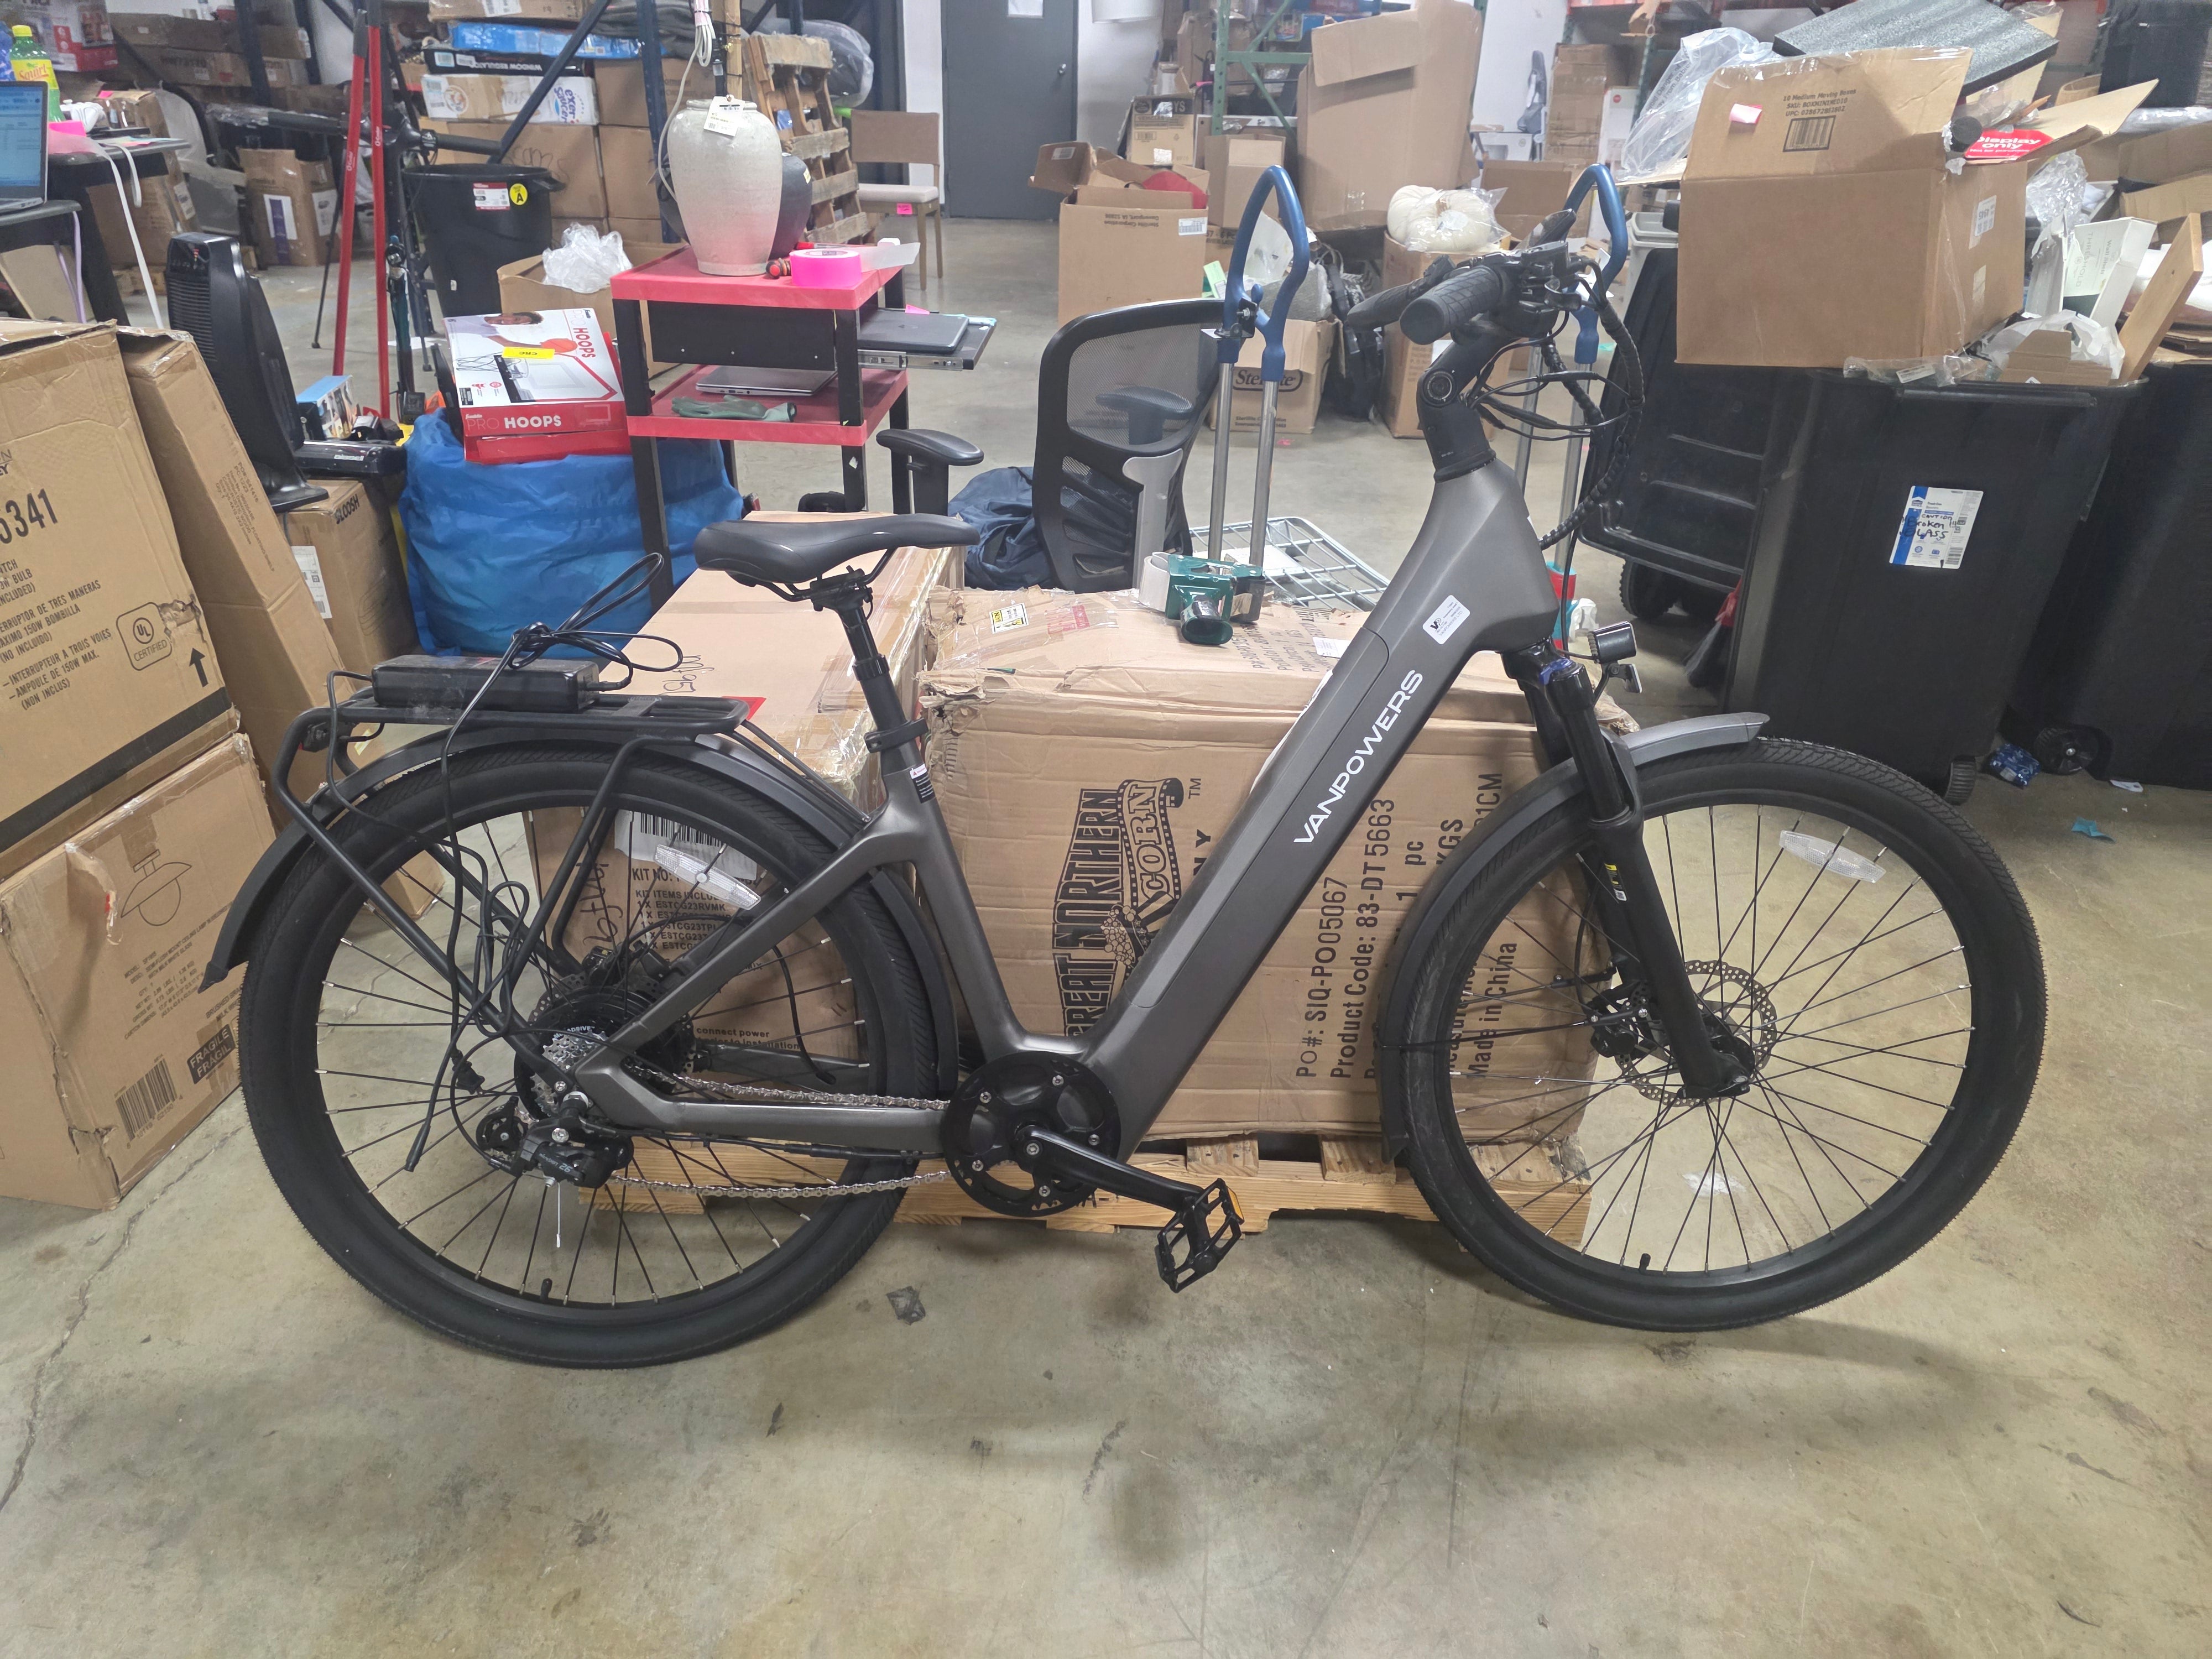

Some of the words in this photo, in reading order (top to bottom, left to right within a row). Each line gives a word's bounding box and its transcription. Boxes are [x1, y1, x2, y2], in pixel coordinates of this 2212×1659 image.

[19, 64, 49, 81] Squirt
[554, 87, 568, 123] saucer
[565, 88, 576, 119] exer
[516, 192, 524, 204] A
[573, 327, 597, 358] HOOPS
[1235, 369, 1296, 387] Stete
[466, 418, 500, 430] PRO
[504, 415, 562, 430] HOOPS
[12, 568, 33, 585] BULB
[36, 603, 49, 615] DE
[48, 594, 67, 610] TRES
[68, 579, 102, 602] MANERAS
[23, 619, 44, 636] 150W
[45, 603, 81, 627] BOMBILLA
[136, 623, 152, 638] UL
[0, 649, 14, 664] (NO
[15, 630, 54, 656] INCLUIDO)
[61, 649, 70, 660] A
[68, 638, 91, 655] TROIS
[90, 627, 112, 644] VOIES
[133, 639, 168, 662] CERTIFIED
[49, 667, 61, 680] DE
[61, 658, 80, 674] 150W
[81, 649, 100, 664] MAX.
[21, 696, 41, 711] (NON
[41, 677, 71, 700] INCLUS)
[1293, 670, 1423, 843] VANPOWERS
[1127, 784, 1174, 900] CORN
[1405, 840, 1427, 867] pc
[632, 868, 650, 882] KIT
[653, 869, 673, 882] NO:
[1052, 788, 1124, 951] NORTHERN
[635, 890, 650, 898] KIT
[653, 890, 682, 899] ITEMS
[656, 900, 726, 911] ESTCG23RVMK
[1396, 891, 1418, 902] 1
[195, 921, 207, 933] LAMP
[646, 911, 653, 919] X
[1344, 936, 1376, 996] Code:
[1484, 943, 1517, 999] China
[205, 994, 231, 1020] BRUSHED
[216, 1009, 229, 1023] MILK
[1479, 1004, 1503, 1022] in
[696, 1027, 737, 1036] connect
[739, 1030, 770, 1038] power
[1330, 1000, 1364, 1079] Product
[190, 1027, 229, 1069] FRAGILE
[1468, 1029, 1491, 1076] Made
